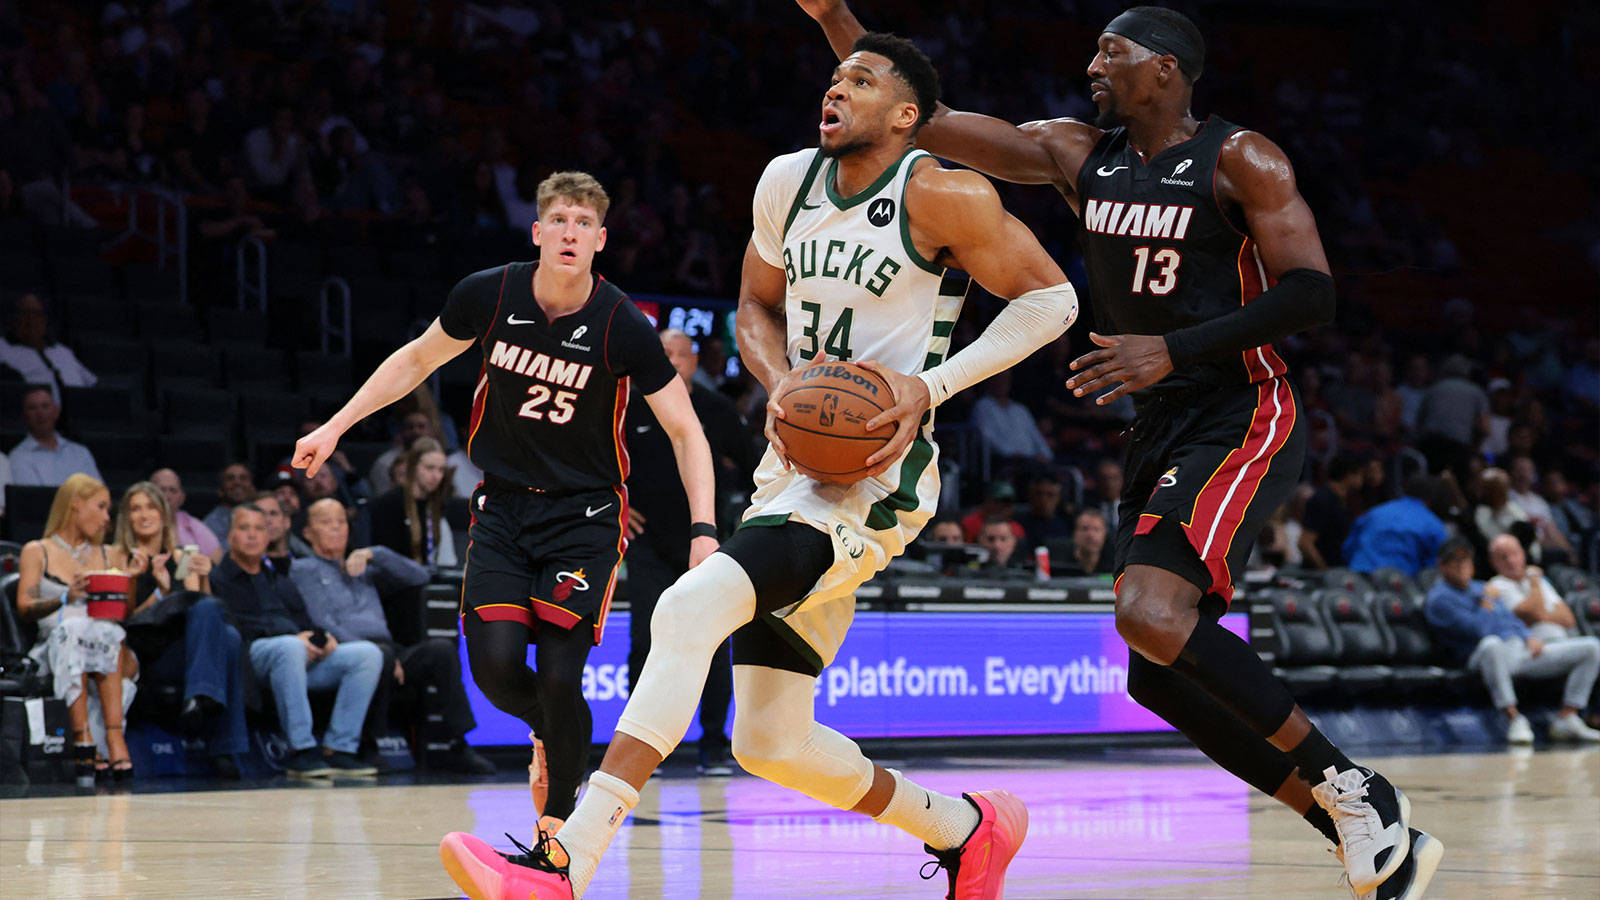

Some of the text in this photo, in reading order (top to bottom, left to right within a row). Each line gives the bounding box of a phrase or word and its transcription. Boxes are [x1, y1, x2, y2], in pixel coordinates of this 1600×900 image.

[1160, 177, 1194, 187] Robinhood
[1085, 198, 1195, 241] MIAMI
[783, 239, 902, 298] BUCKS
[1130, 245, 1182, 296] 13
[799, 300, 854, 362] 34
[489, 340, 593, 390] MIAMI
[801, 365, 879, 398] Wilson
[518, 383, 579, 425] 25
[827, 656, 978, 706] platform.
[985, 657, 1130, 704] Everythin
